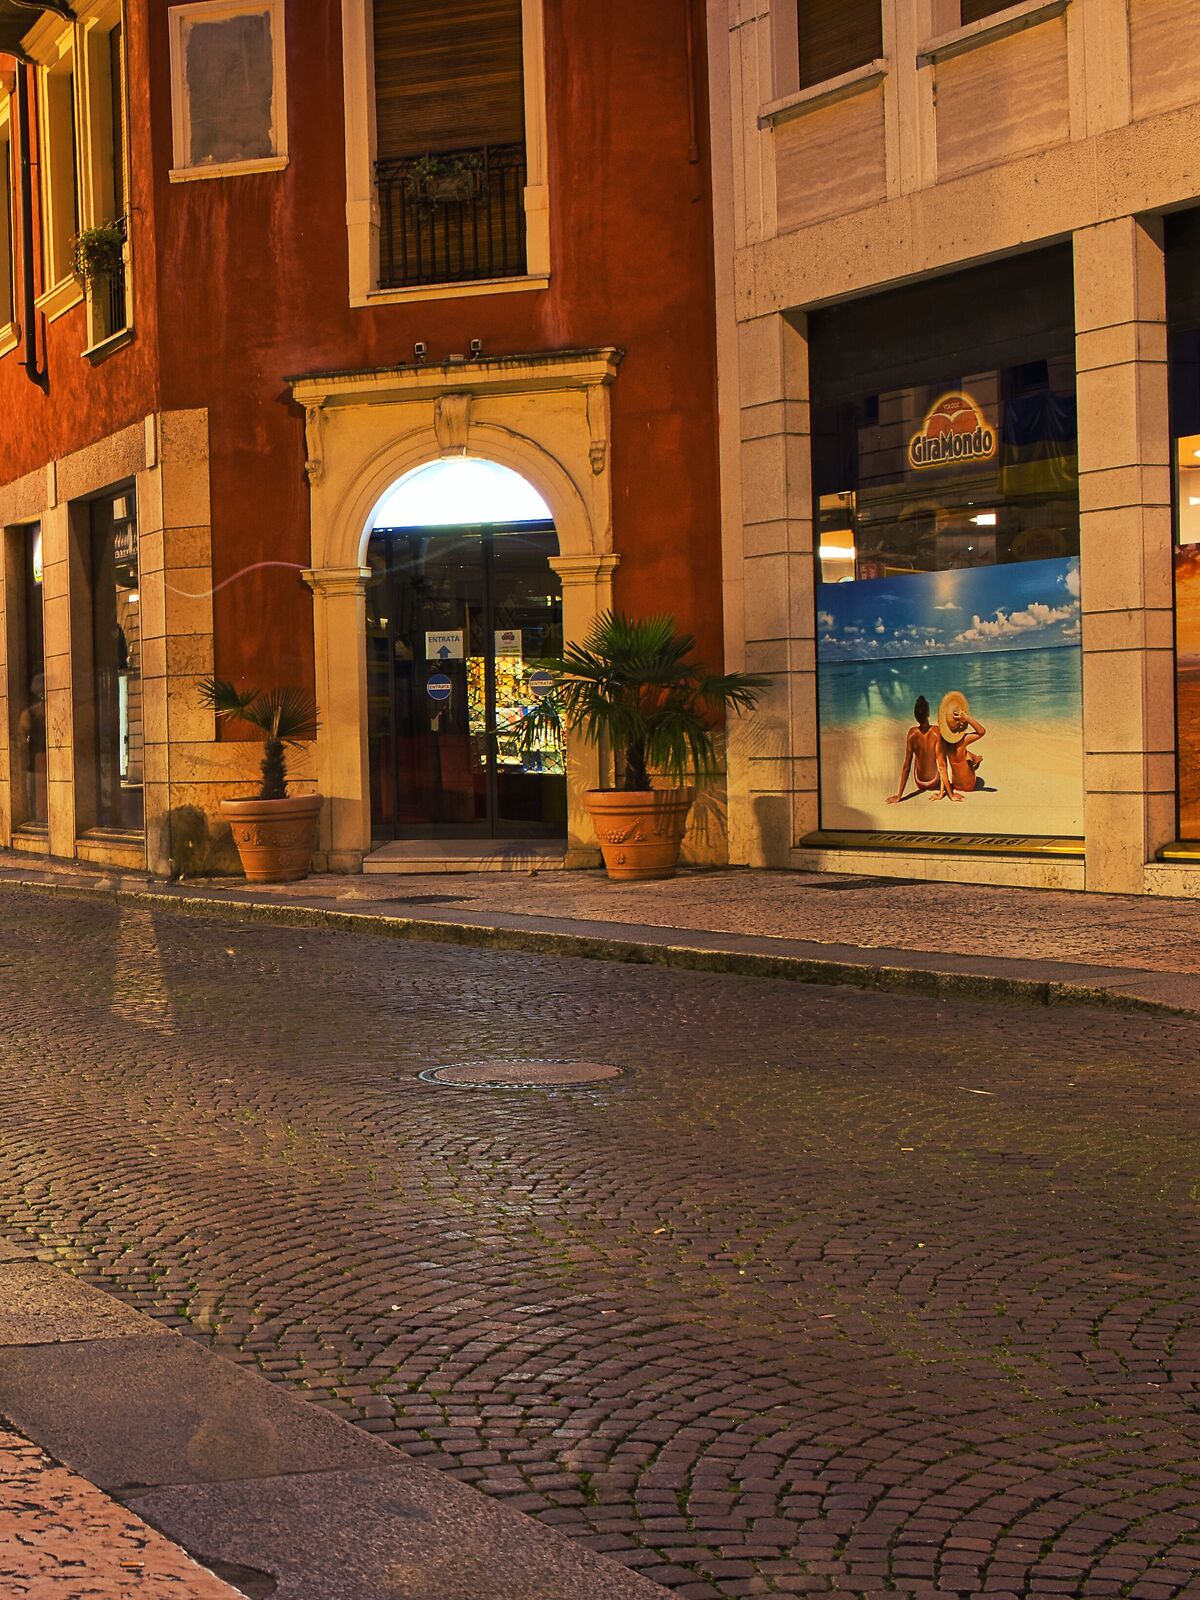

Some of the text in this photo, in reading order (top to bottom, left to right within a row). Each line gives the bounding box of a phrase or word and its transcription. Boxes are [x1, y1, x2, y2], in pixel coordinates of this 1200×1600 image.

[910, 426, 993, 465] GiraMondo
[428, 635, 460, 643] ENTRATA
[868, 834, 1028, 846] GIRAMONDO VIAGGI
